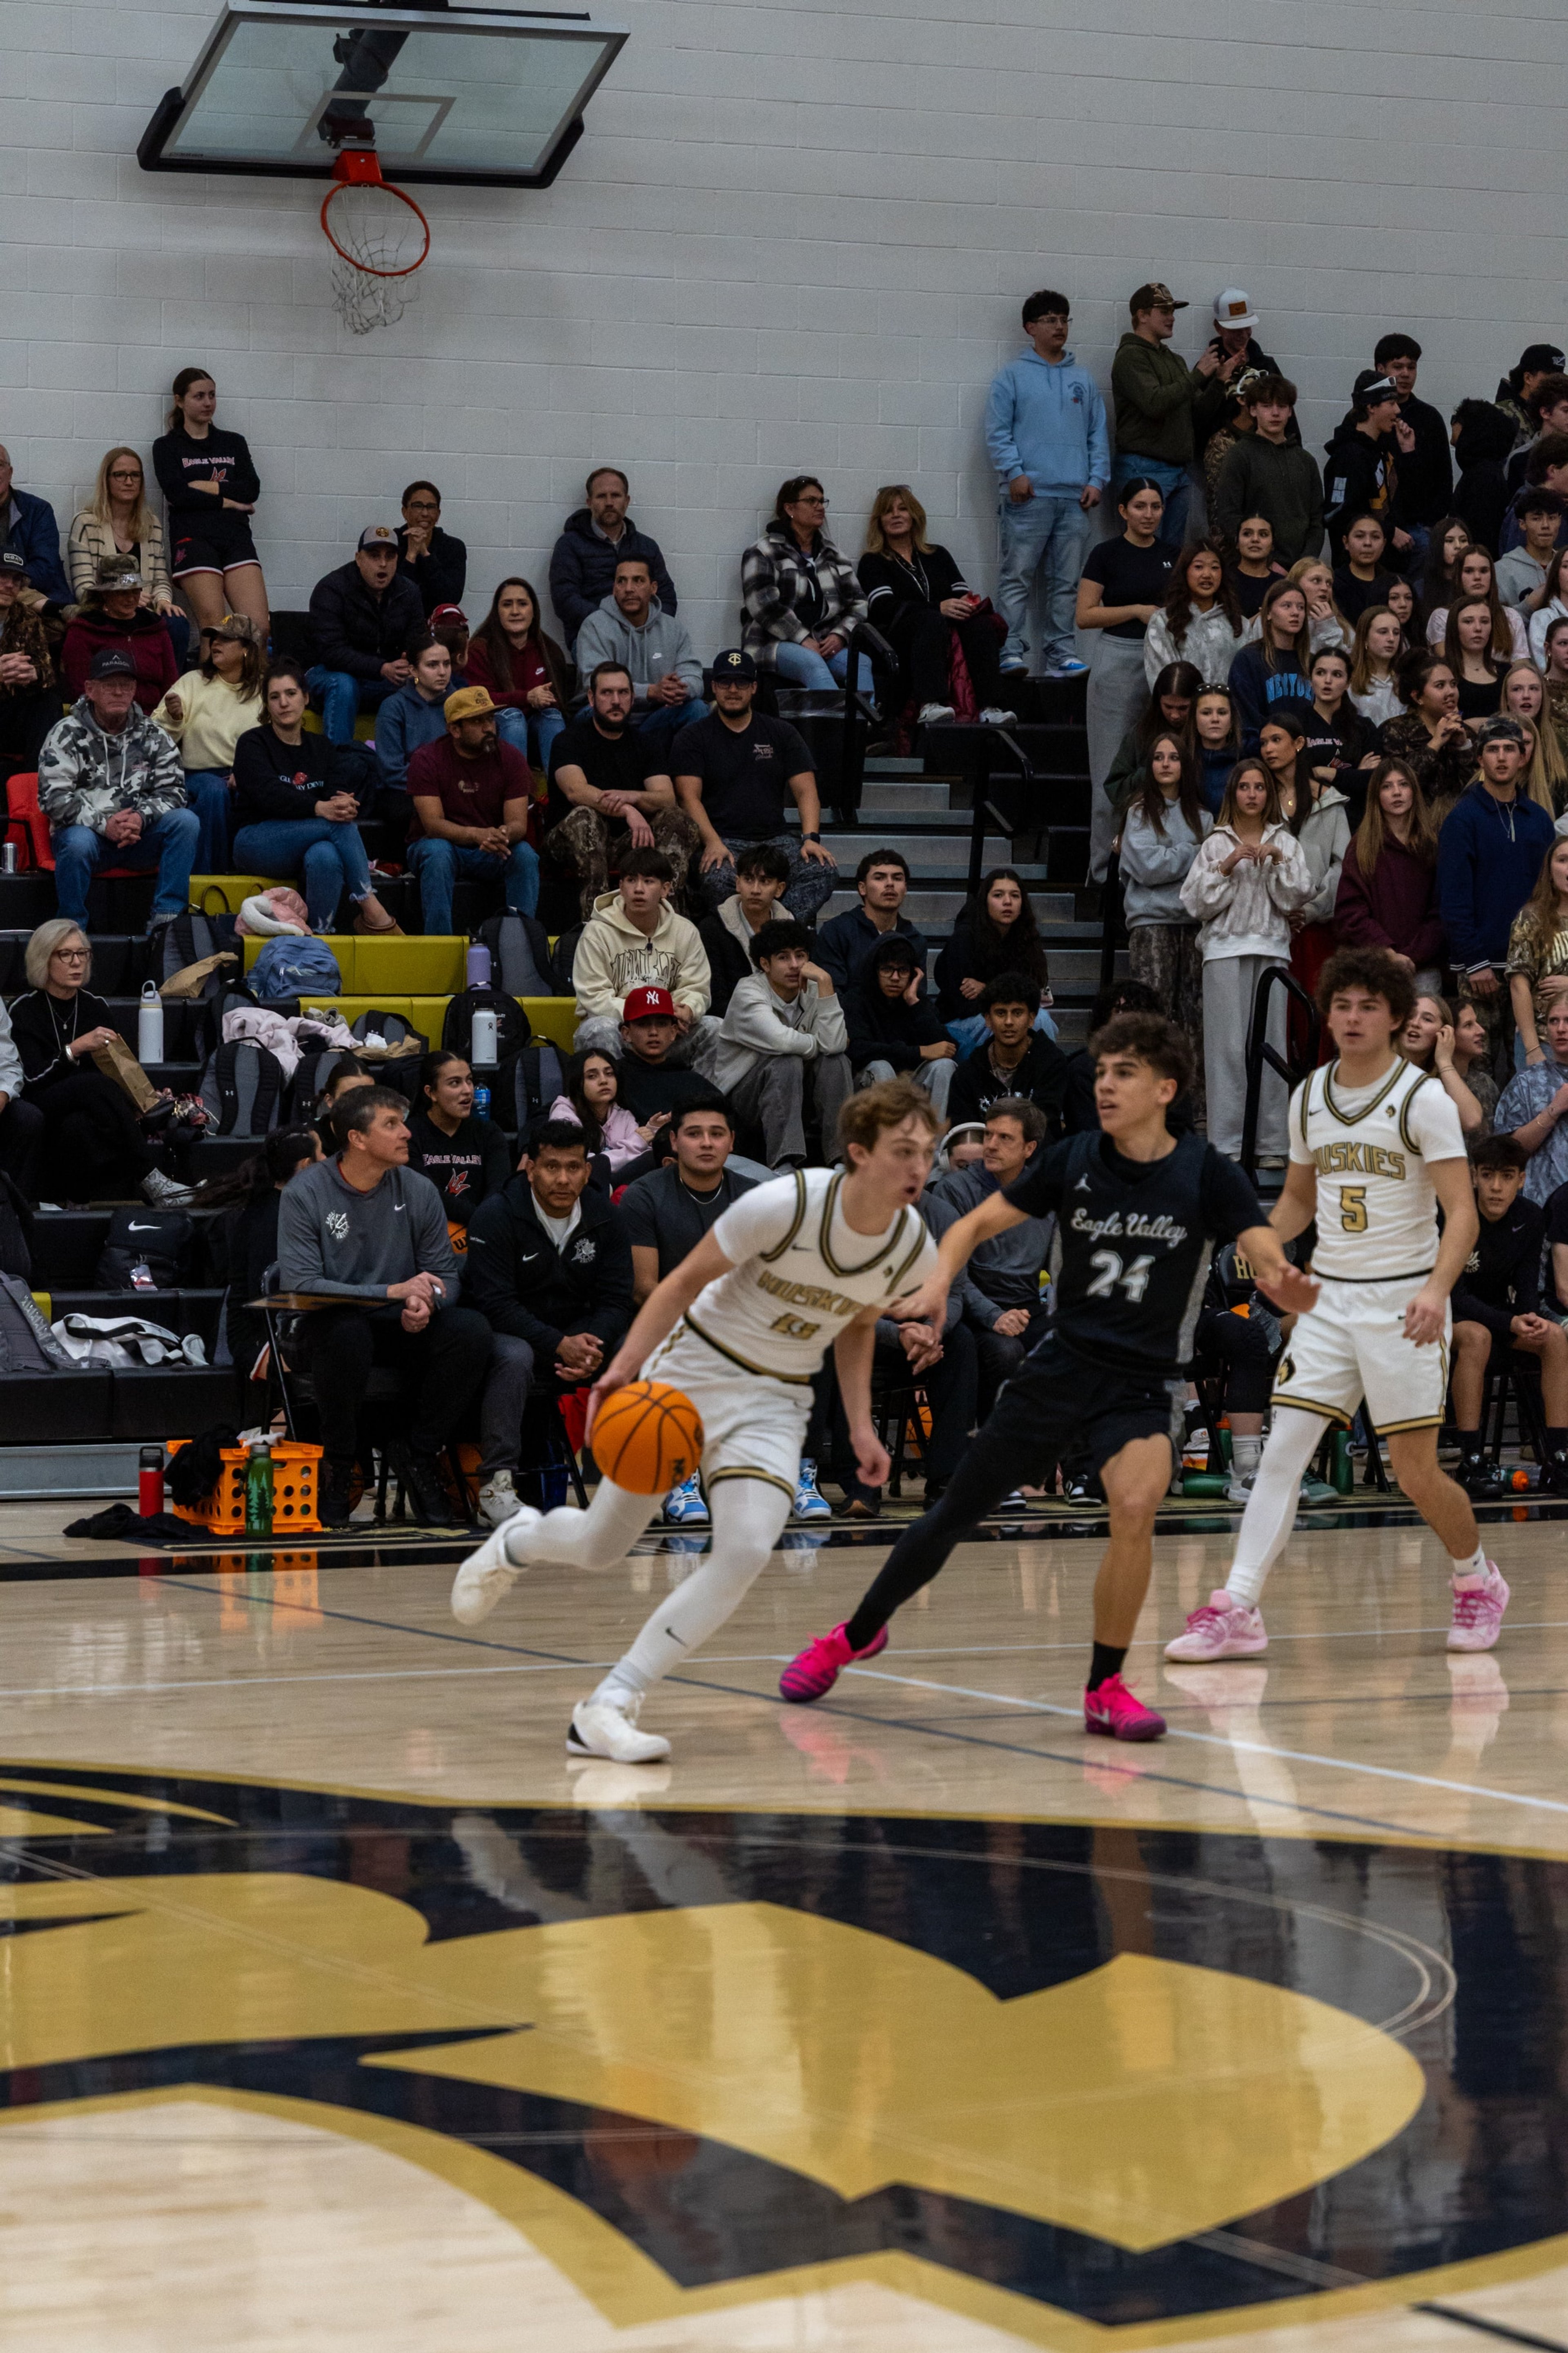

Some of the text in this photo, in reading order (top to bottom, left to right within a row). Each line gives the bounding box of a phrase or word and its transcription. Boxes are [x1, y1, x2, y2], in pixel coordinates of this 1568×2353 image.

[1306, 737, 1333, 748] EAGLE
[646, 990, 659, 1005] NY
[422, 1153, 481, 1166] EAGLE VALLEY
[1340, 1186, 1368, 1233] 5
[1070, 1207, 1188, 1250] Eagle Valley
[1085, 1248, 1156, 1303] 24
